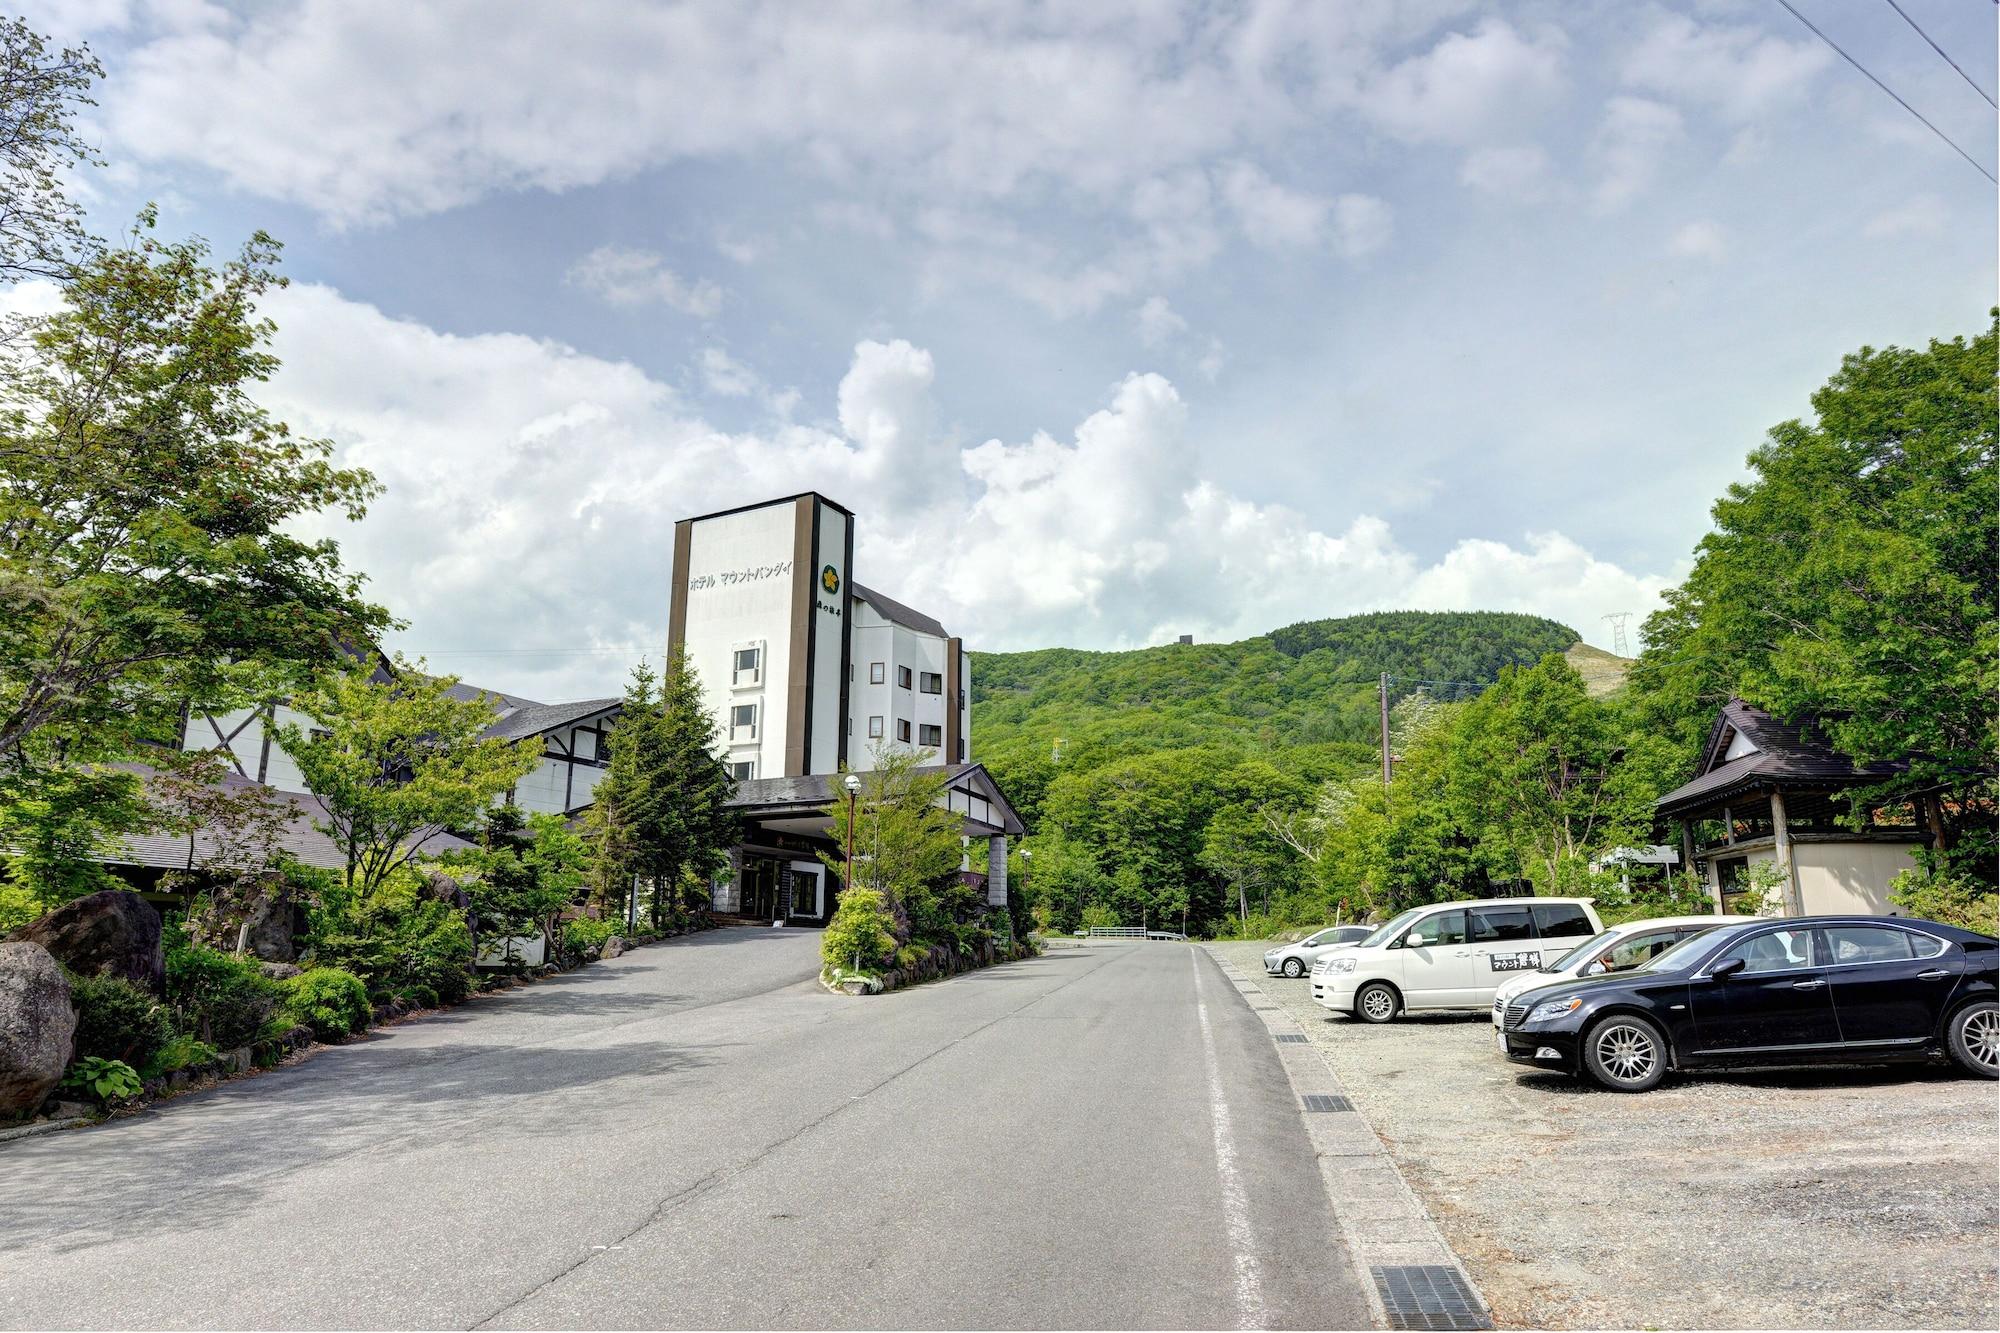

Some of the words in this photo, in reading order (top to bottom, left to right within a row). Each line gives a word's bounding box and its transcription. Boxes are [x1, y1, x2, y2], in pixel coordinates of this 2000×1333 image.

[690, 574, 716, 591] ホテル
[720, 561, 793, 586] マウントバンダイ
